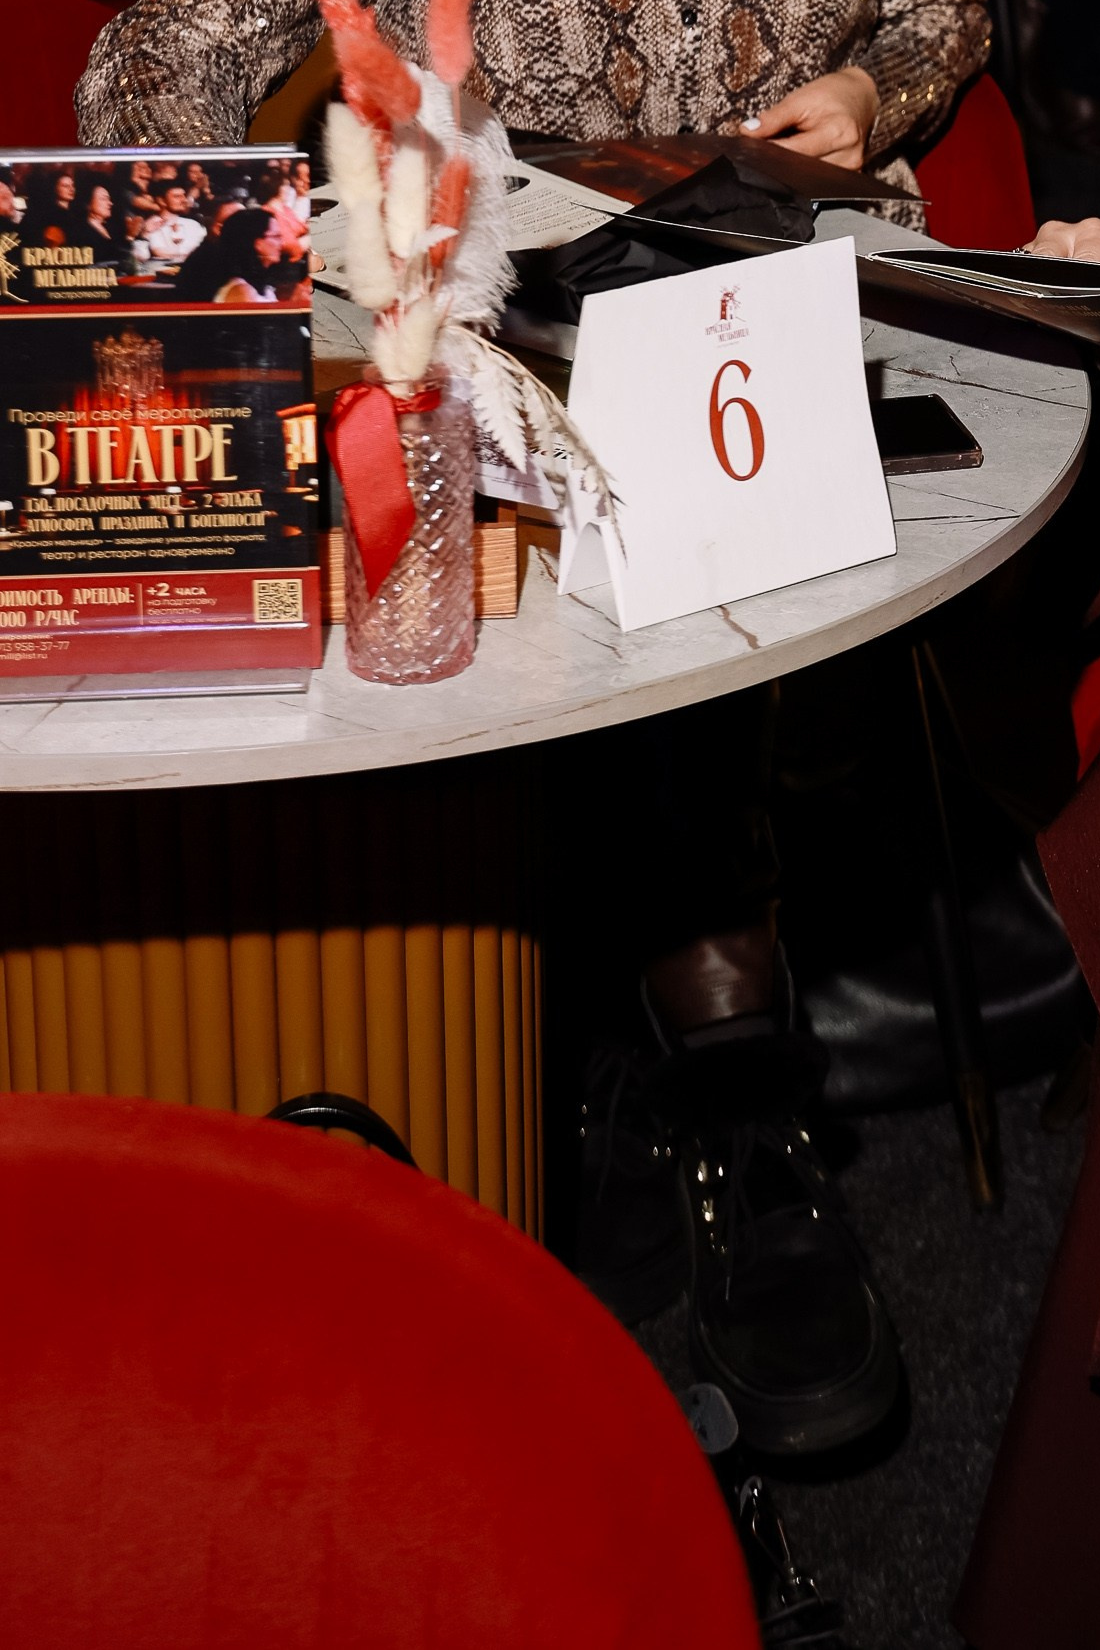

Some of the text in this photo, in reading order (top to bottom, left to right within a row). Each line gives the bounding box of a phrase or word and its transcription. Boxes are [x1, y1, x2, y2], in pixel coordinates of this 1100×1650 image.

[23, 246, 94, 266] КРАСНАЯ
[34, 267, 119, 288] МЕЛЬНИЦА
[8, 406, 252, 425] Проведи своё мероприятие
[709, 358, 766, 482] 6
[26, 423, 238, 486] В ТЕАТРЕ
[53, 496, 142, 512] ПОСАДОЧНЫХ
[149, 494, 182, 509] МЕСТ
[202, 493, 213, 508] 2
[220, 492, 263, 507] ЭТАЖА
[27, 513, 266, 532] АТМОСФЕРА ПРАЗДНИКА И БОГЕМНОСТИ
[40, 551, 76, 561] театр
[88, 549, 147, 560] ресторан
[148, 548, 236, 558] одновременно
[72, 587, 135, 605] АРЕНДЫ:
[146, 582, 171, 597] +2
[34, 609, 80, 626] Р/ЧАС
[15, 641, 70, 652] 958-37-77
